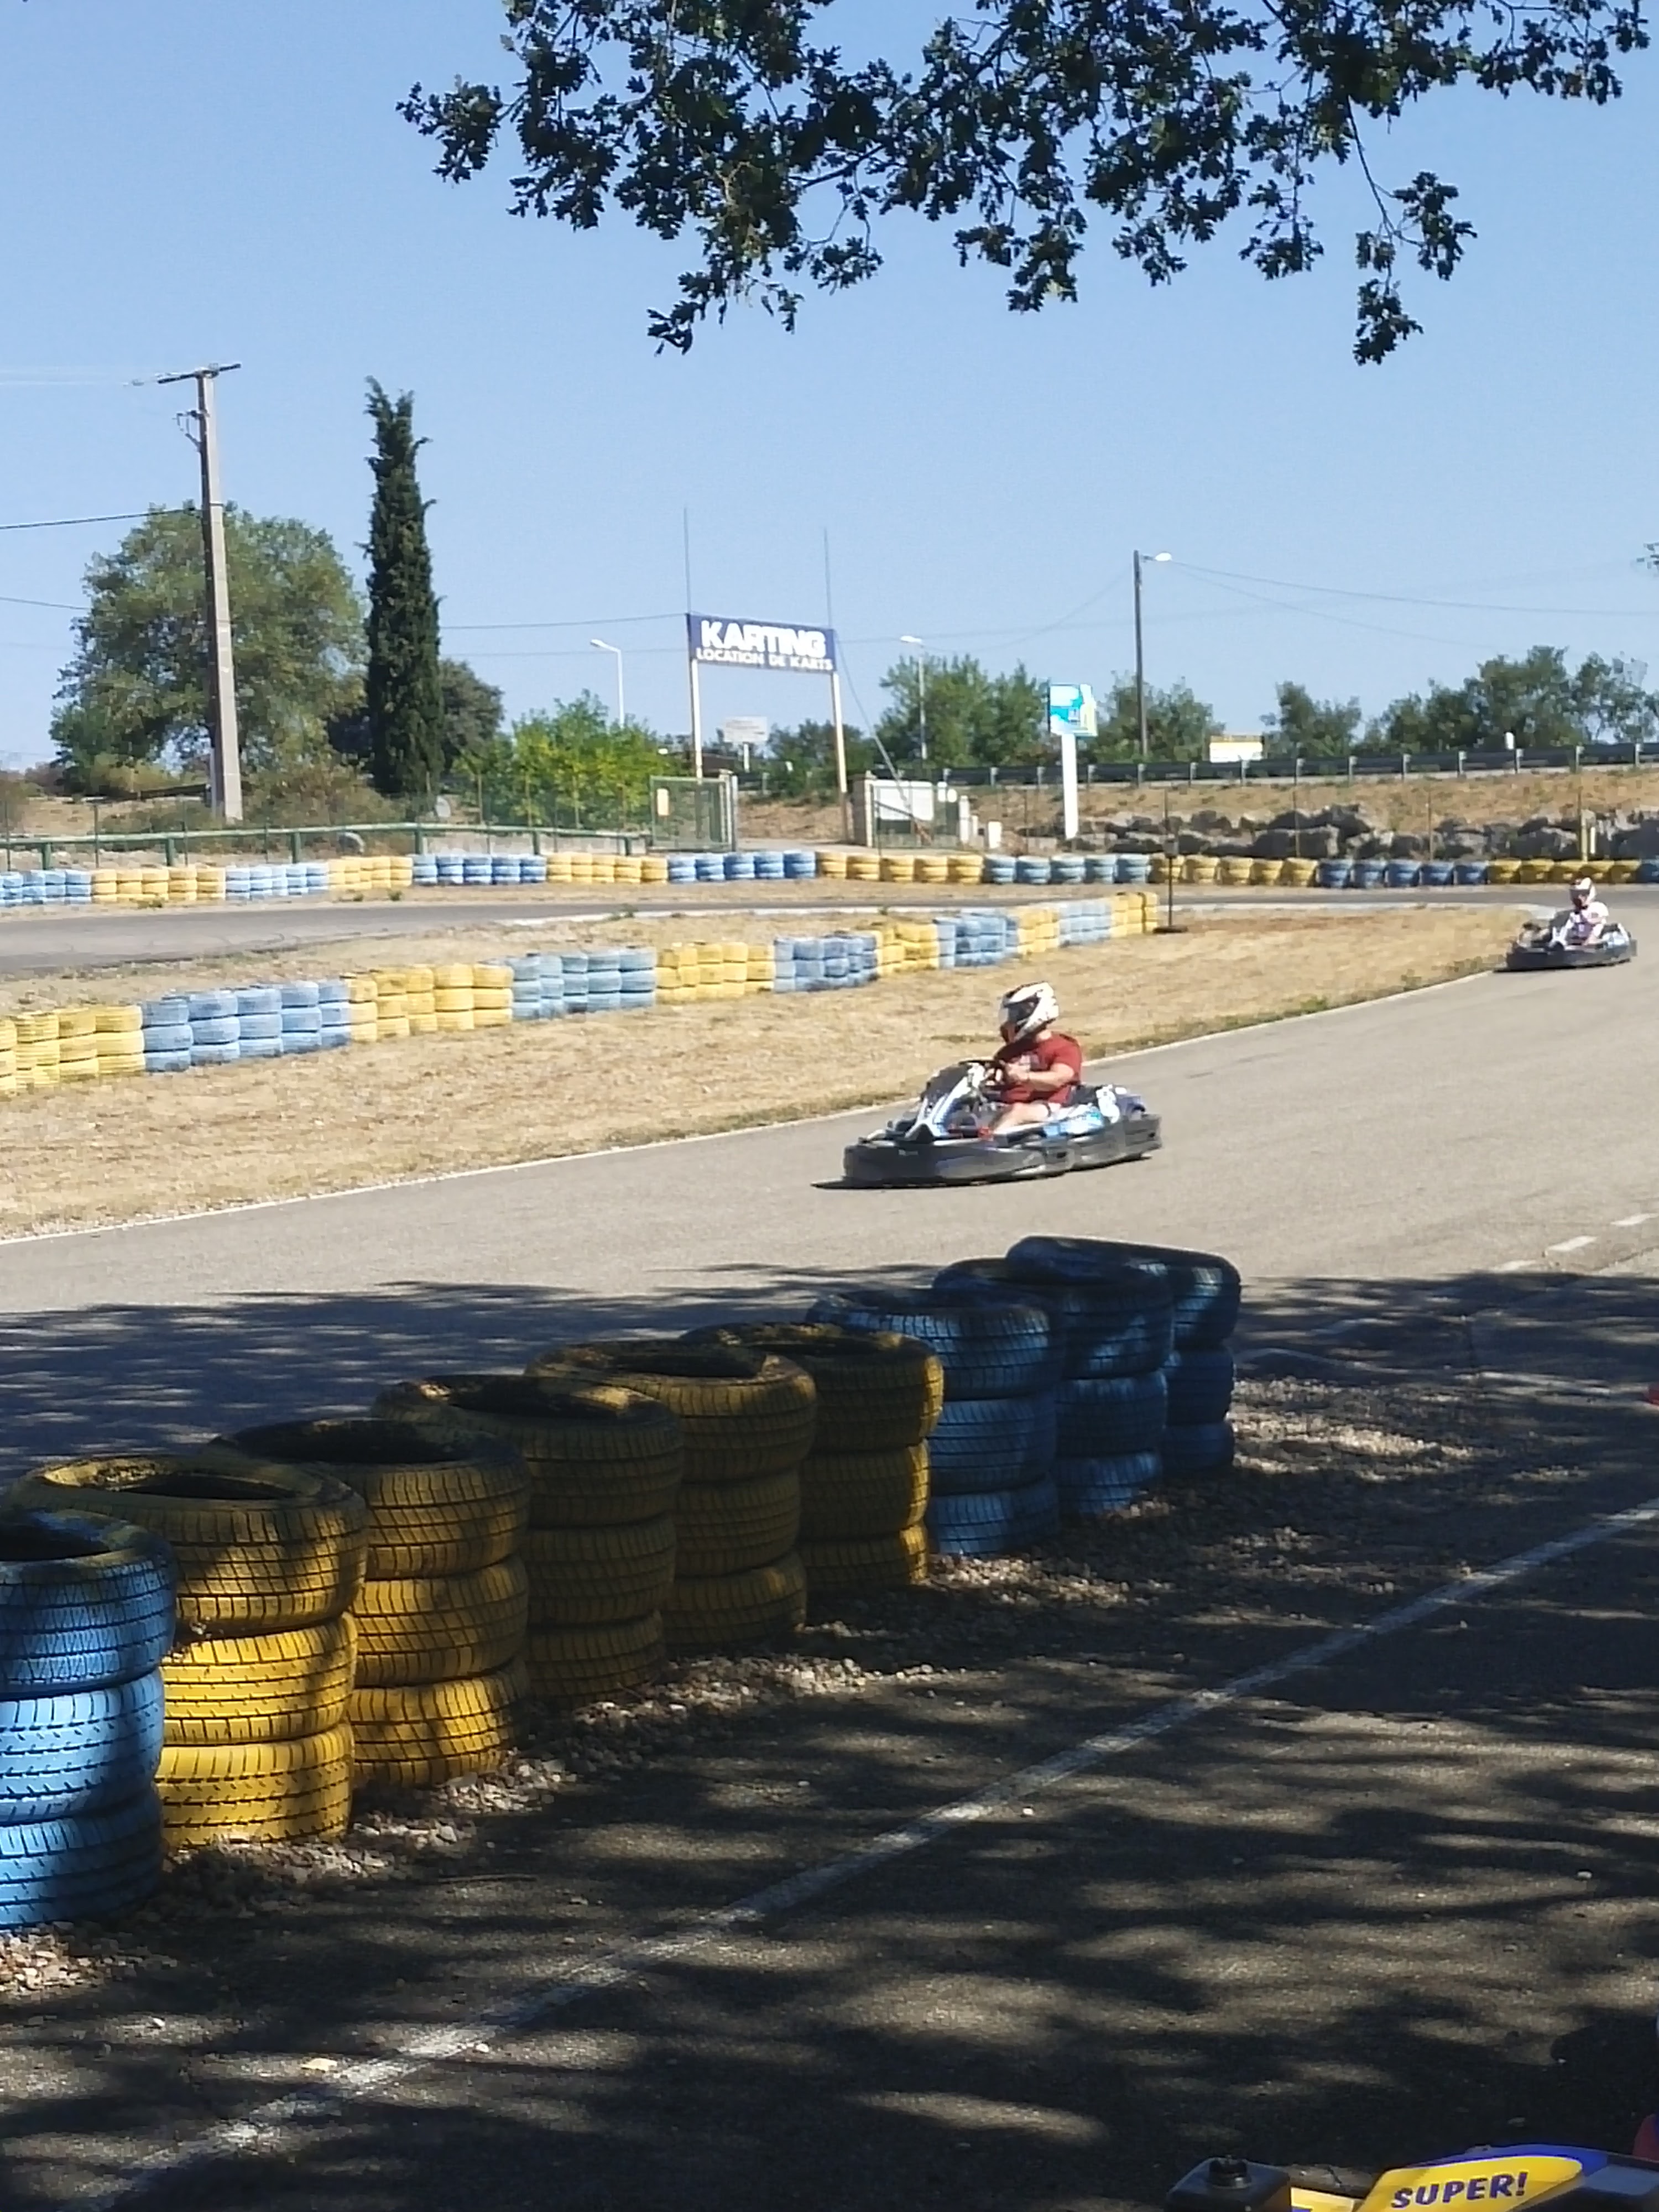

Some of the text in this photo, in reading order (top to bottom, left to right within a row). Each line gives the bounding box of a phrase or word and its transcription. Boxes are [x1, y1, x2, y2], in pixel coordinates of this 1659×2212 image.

[696, 648, 764, 664] LOCATION
[701, 620, 826, 658] KARTING
[1391, 2171, 1528, 2208] SUPER!
